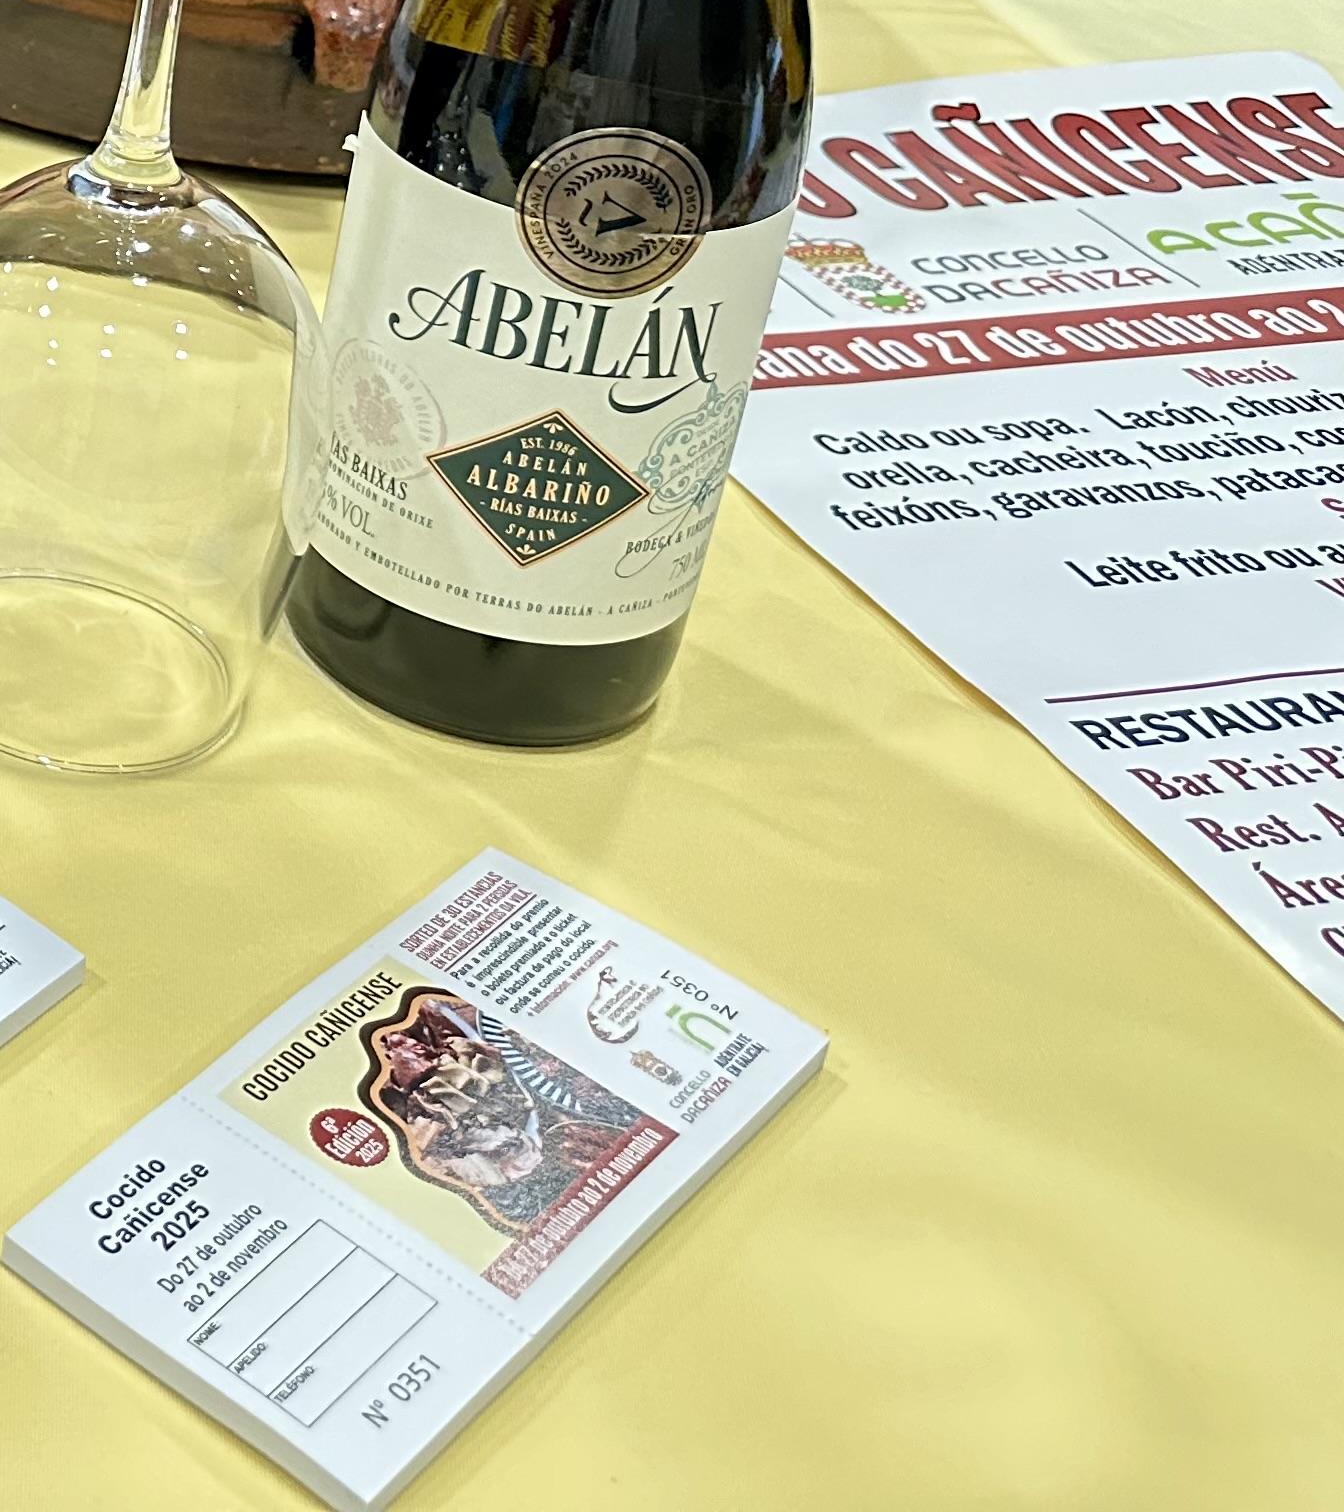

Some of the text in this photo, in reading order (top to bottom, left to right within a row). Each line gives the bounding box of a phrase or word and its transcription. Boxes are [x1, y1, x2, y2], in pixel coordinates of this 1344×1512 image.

[543, 151, 579, 180] 2024
[821, 91, 1344, 212] CAÑICENSE
[684, 184, 698, 215] ORO
[911, 245, 1110, 275] CONCELLO
[1145, 229, 1217, 255] A
[924, 266, 1172, 303] DACAÑIZA
[388, 269, 725, 414] ABELÁN
[847, 336, 928, 372] do
[913, 330, 993, 365] 27
[985, 326, 1054, 359] de
[1053, 311, 1262, 355] outubro
[1247, 306, 1328, 336] ao
[1181, 359, 1300, 388] Menú
[520, 437, 578, 456] EST. 1986
[813, 401, 1234, 457] Caldo ou sopa. Lacón,
[351, 453, 408, 500] BAIXAS
[502, 450, 588, 476] ABELÁN
[842, 431, 1304, 490] orella, cacheira, touciño,
[466, 464, 610, 506] ALBARIÑO
[830, 480, 1223, 532] feixóns, garavanzos,
[399, 507, 433, 529] ORIXE
[490, 496, 578, 524] RÍAS BAIXAS
[505, 523, 557, 542] SPAIN
[625, 535, 672, 556] BODEGA
[363, 546, 652, 617] EMBOTELLADO POR TERRAS DO ABELÁN CAÑIZA
[1064, 547, 1324, 590] Leite frito ou
[1125, 767, 1224, 800] Bar
[1185, 814, 1322, 852] Rest.
[242, 971, 403, 1102] COCIDO CAÑICENSE
[325, 1118, 376, 1160] Edición
[88, 1157, 166, 1222] Cocido
[97, 1161, 210, 1256] Cañicense
[150, 1200, 211, 1252] 2025
[213, 1202, 263, 1247] outubro
[228, 1217, 288, 1274] novembro
[361, 1353, 441, 1428] Nº 0351
